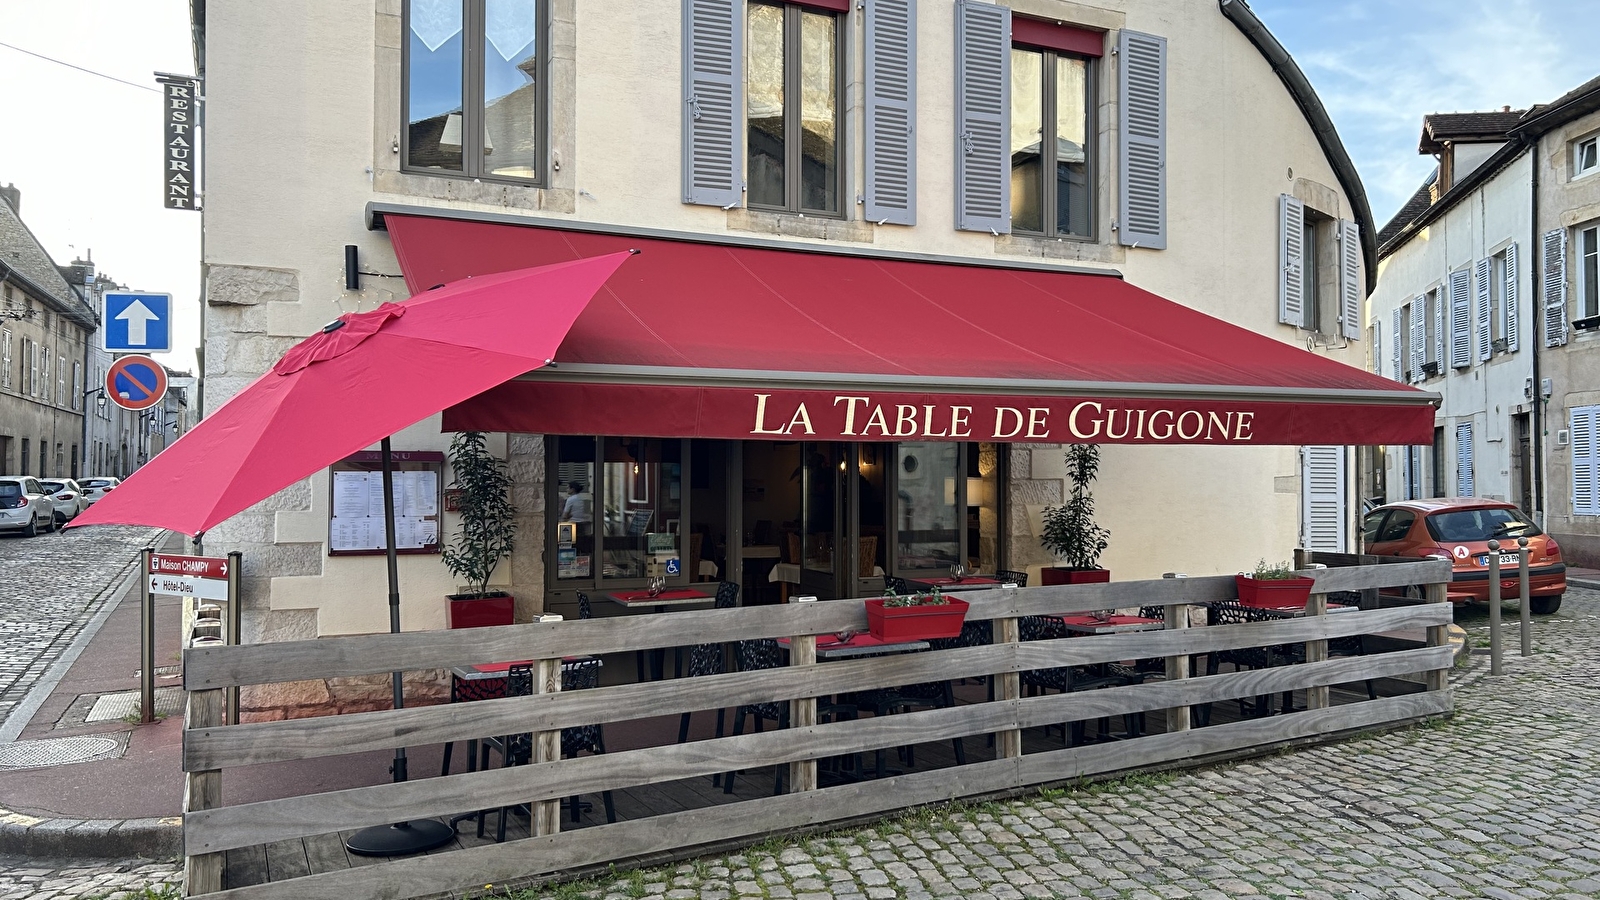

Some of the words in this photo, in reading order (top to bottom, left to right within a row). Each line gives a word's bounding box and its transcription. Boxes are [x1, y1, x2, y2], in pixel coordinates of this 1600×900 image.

[169, 86, 190, 208] RESTAURANT
[833, 396, 973, 437] TABLE
[991, 406, 1050, 438] DE
[1068, 401, 1255, 441] GUIGONE
[367, 452, 411, 460] MNU
[1458, 547, 1466, 556] A
[160, 559, 181, 571] Maison
[182, 560, 209, 573] CHAMPY
[163, 580, 194, 593] Hôtel-Dieu
